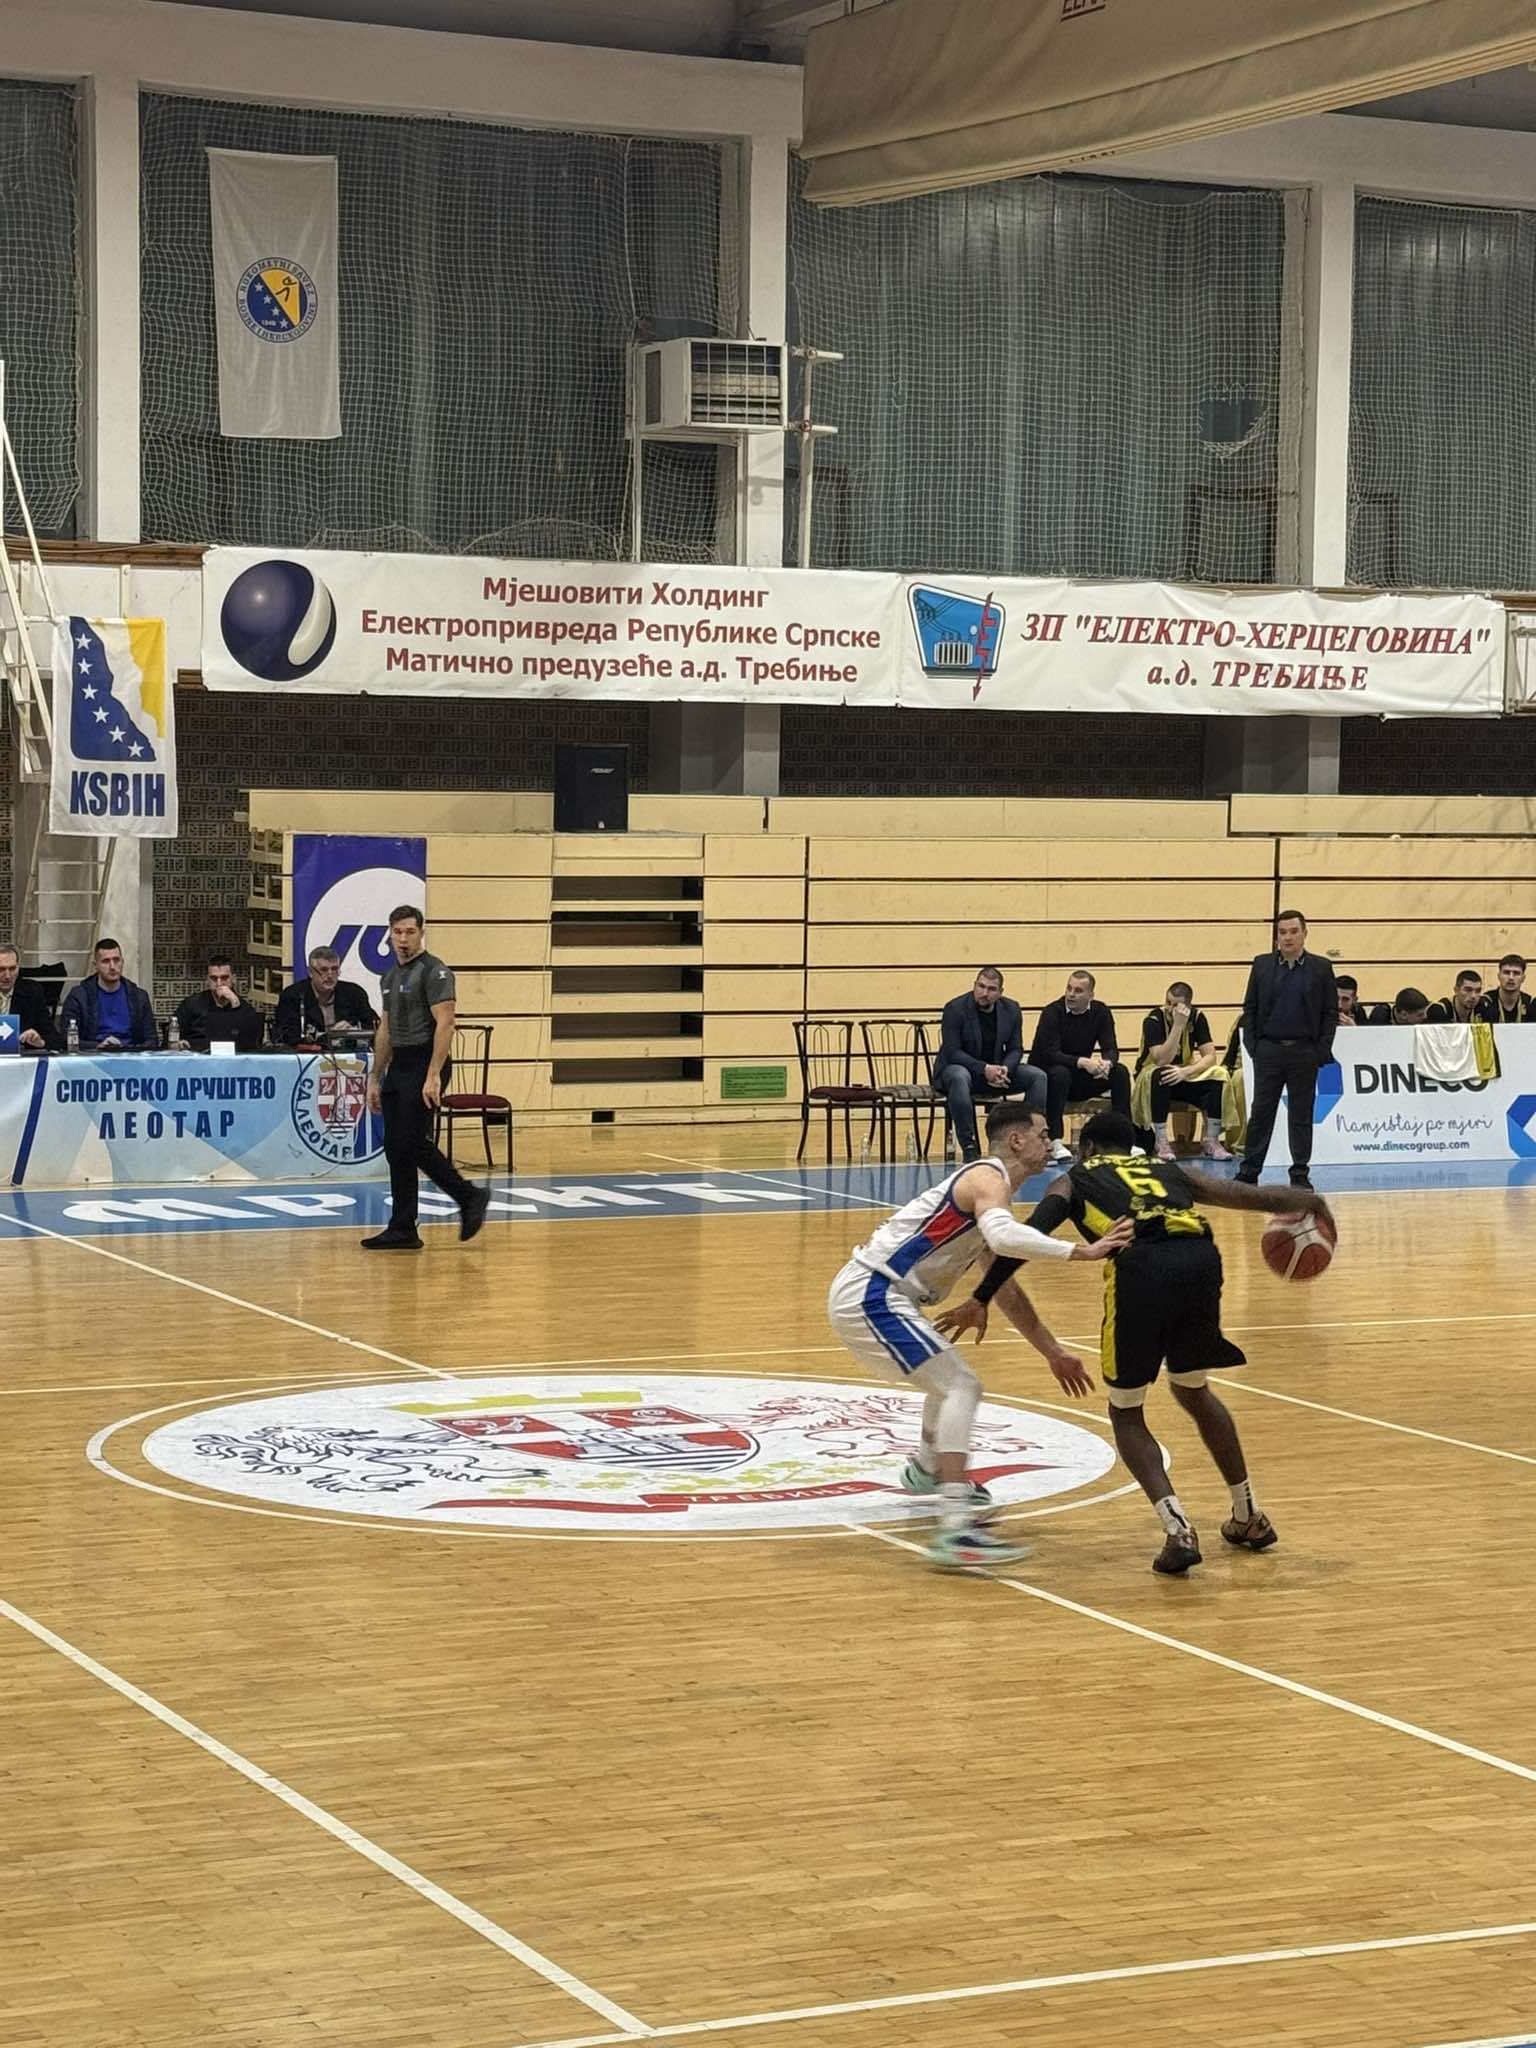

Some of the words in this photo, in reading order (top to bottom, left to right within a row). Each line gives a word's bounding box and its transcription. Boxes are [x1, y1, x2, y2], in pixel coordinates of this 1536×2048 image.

[483, 576, 643, 607] Мјешовити
[651, 582, 769, 610] Холдинг
[361, 609, 617, 645] Електропривреда
[627, 618, 778, 648] Републике
[785, 622, 881, 651] Српске
[1020, 612, 1067, 642] ЗП
[1075, 613, 1491, 657] "ЕЛЕКТРО-ХЕРЦЕГОВИНА"
[386, 647, 513, 675] Матично
[522, 653, 672, 681] предузеће
[680, 660, 727, 682] а.д.
[735, 656, 858, 685] Требиње
[1147, 659, 1198, 687] а.д.
[1211, 660, 1369, 691] ТРЕБИЊЕ
[69, 770, 165, 817] KSBIH
[56, 1076, 169, 1103] СПОРТСКО
[175, 1076, 276, 1100] ДРУШТВО
[296, 1078, 314, 1103] СД
[98, 1110, 235, 1139] ЛЕОТАР
[295, 1108, 353, 1159] ЛЕОТАР
[1426, 1119, 1445, 1137] po
[1353, 1140, 1470, 1153] www.dinecogroup.com
[684, 1485, 864, 1503] ТРЕБИЊЕ
